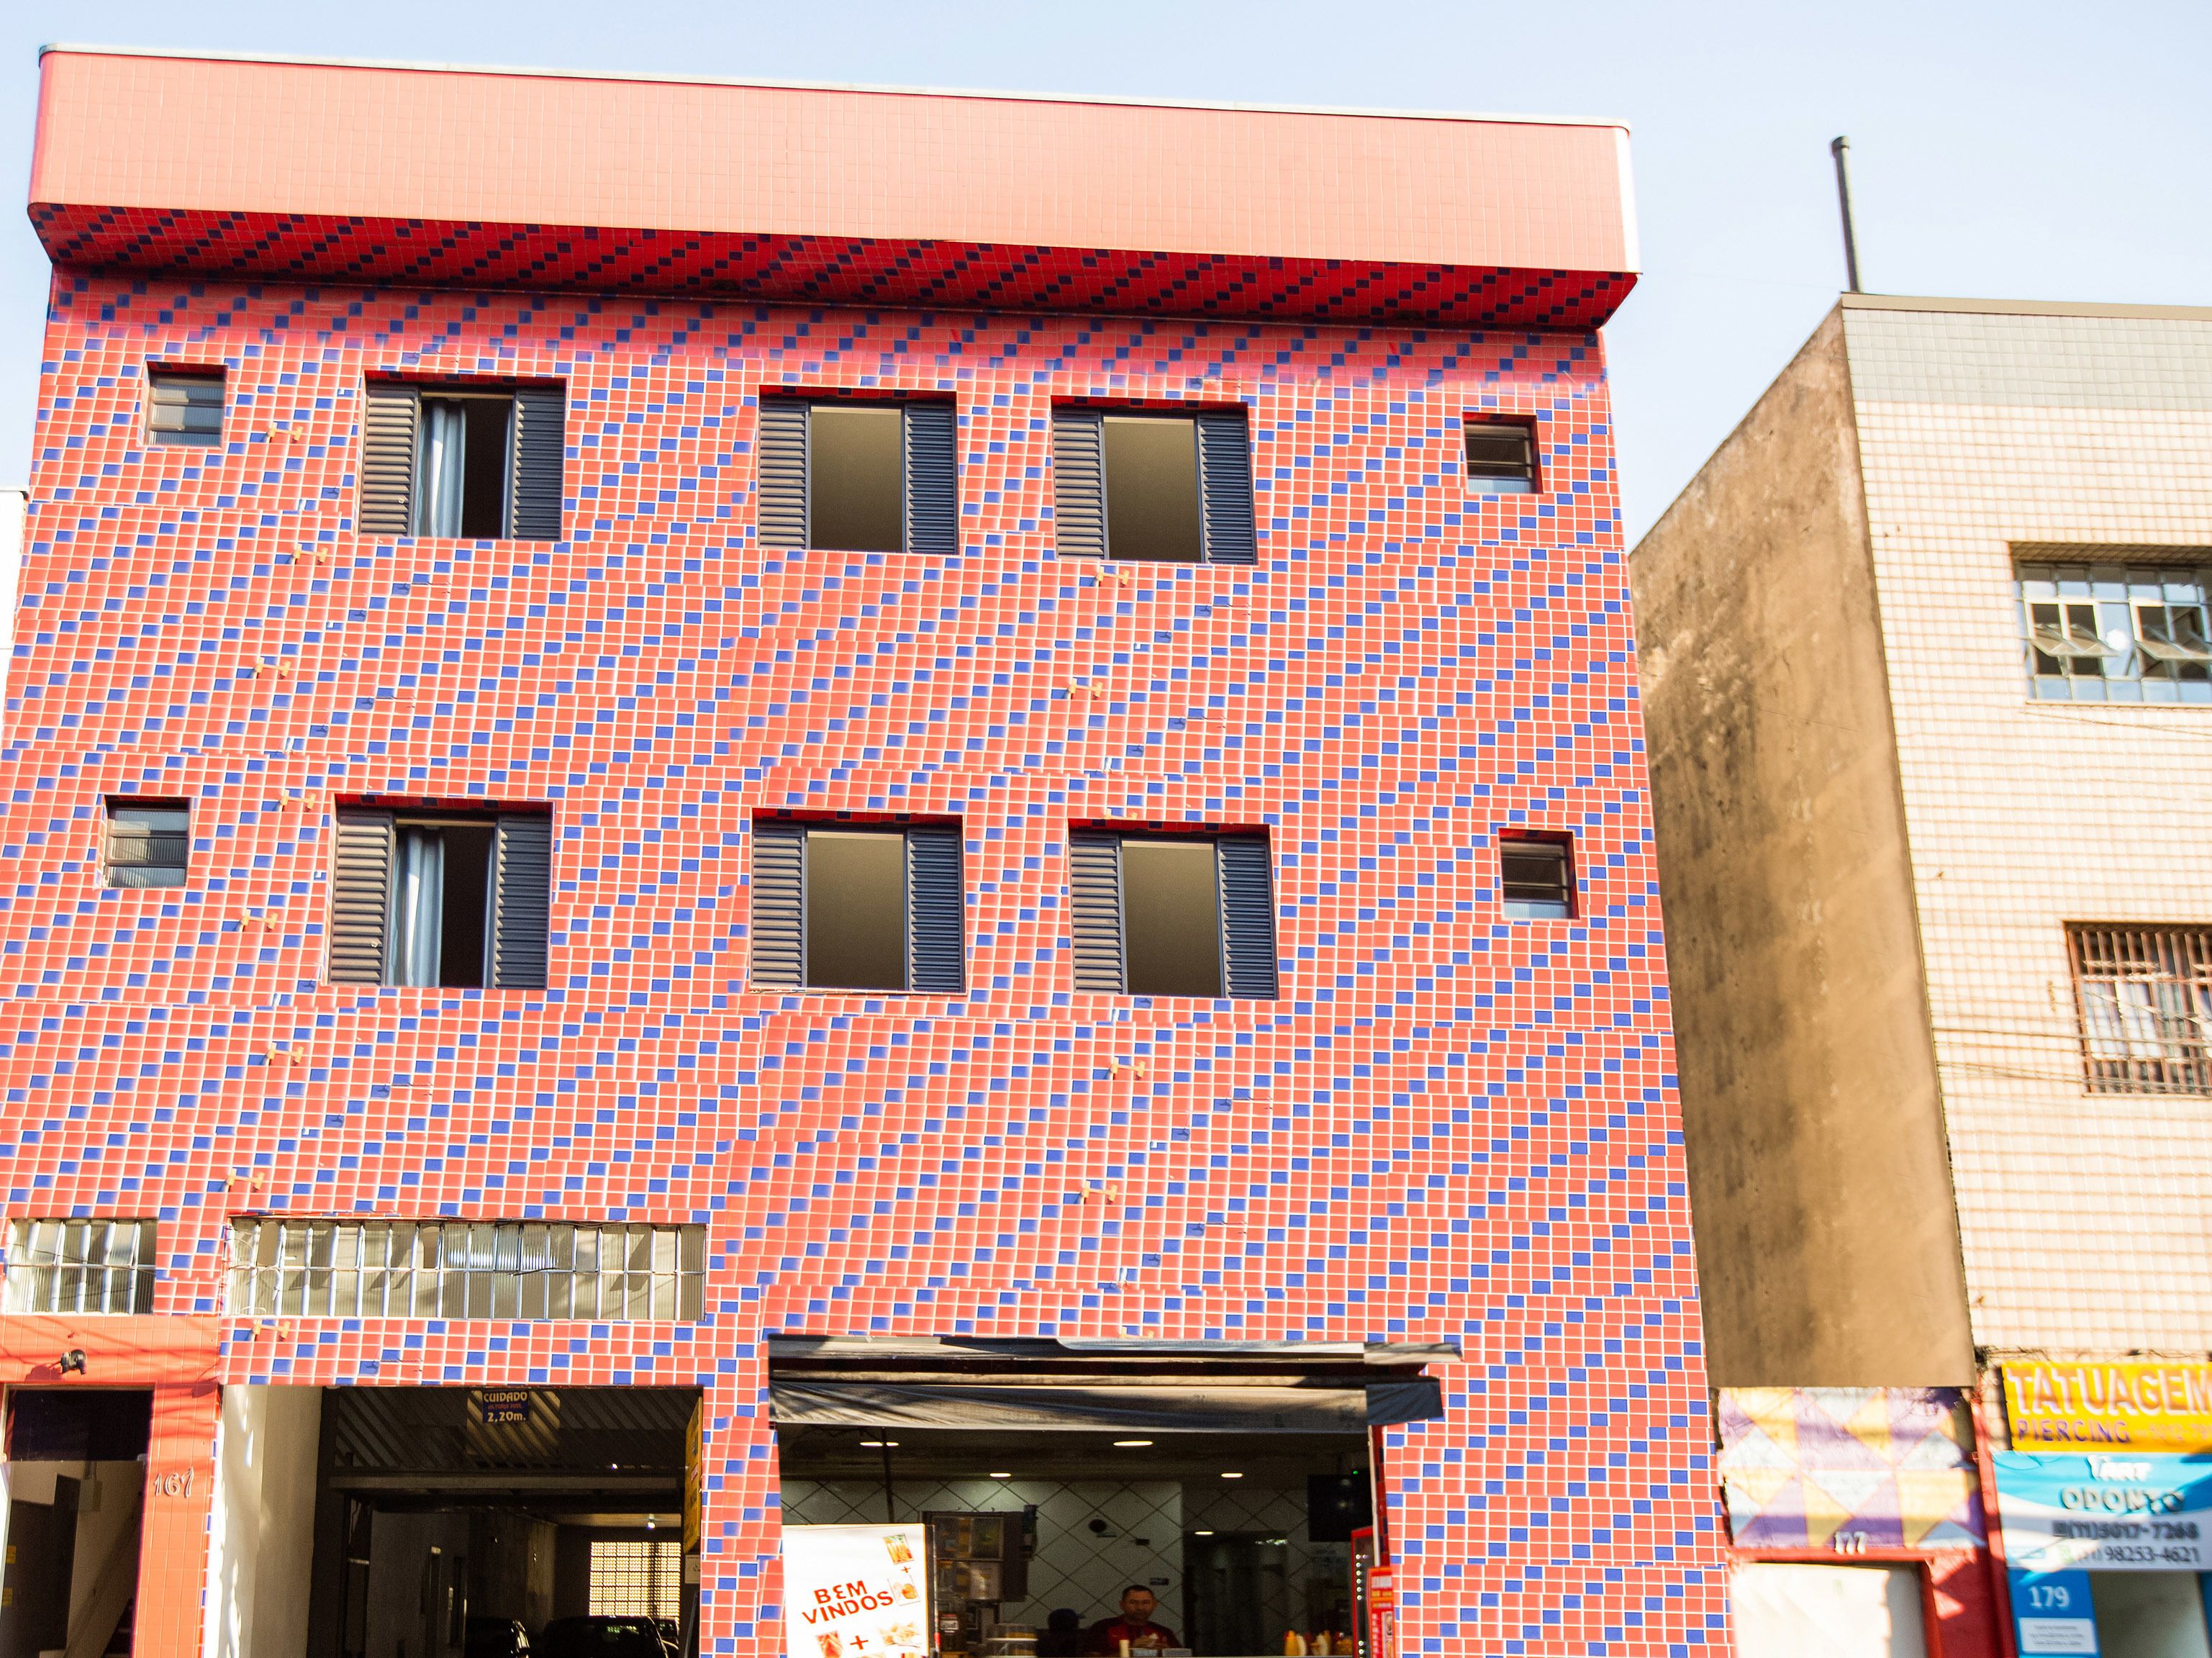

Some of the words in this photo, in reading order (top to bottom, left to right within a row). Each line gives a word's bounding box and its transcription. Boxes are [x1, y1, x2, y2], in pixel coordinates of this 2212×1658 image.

[484, 1392, 527, 1403] CUIDADO
[2006, 1367, 2212, 1416] TATUAGEM
[2016, 1418, 2131, 1444] PIERCING
[153, 1467, 195, 1498] 167
[2059, 1487, 2185, 1514] ODONTO
[814, 1580, 868, 1604] BEM
[2028, 1585, 2070, 1608] 179
[802, 1591, 894, 1624] VINDOS
